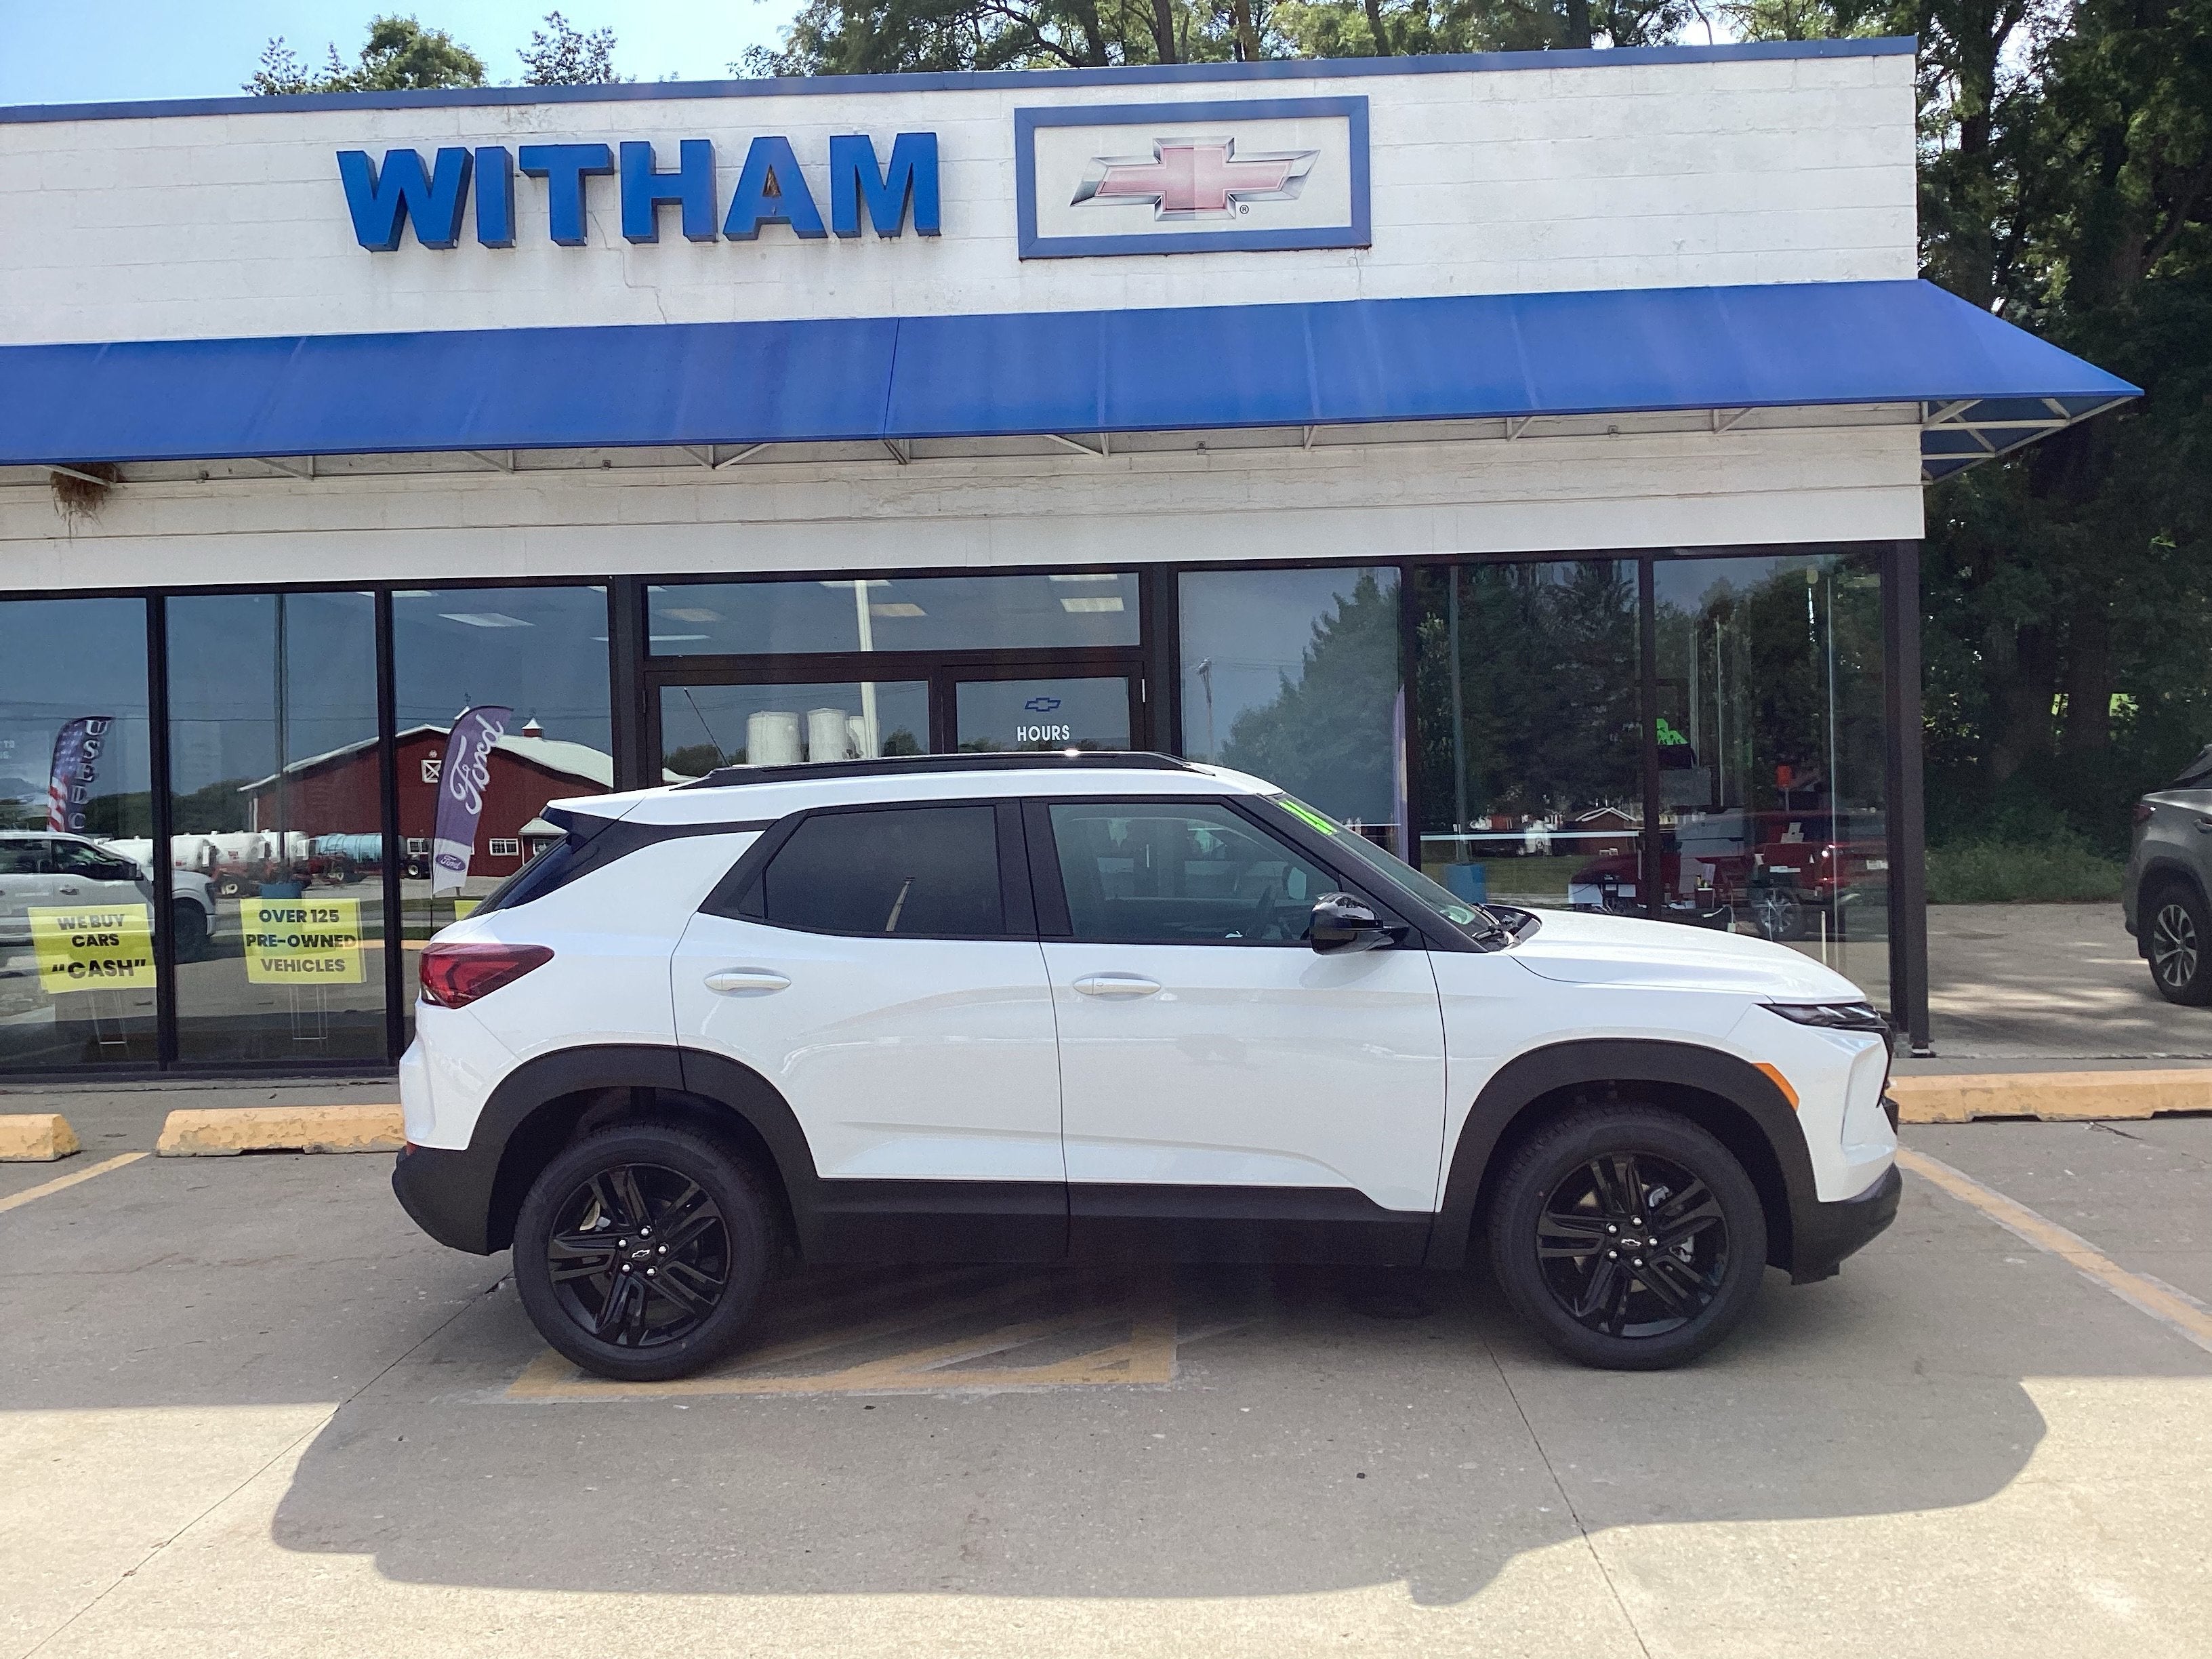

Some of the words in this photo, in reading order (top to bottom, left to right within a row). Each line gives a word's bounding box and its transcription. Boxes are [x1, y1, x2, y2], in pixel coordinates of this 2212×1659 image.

[337, 133, 942, 251] WITHAM
[1017, 724, 1070, 741] HOURS
[69, 720, 110, 804] USED
[450, 714, 504, 815] Ford
[440, 855, 462, 870] Ford
[57, 916, 87, 930] WE
[89, 914, 125, 928] BUY
[259, 909, 307, 923] OVER
[310, 909, 340, 923] 125
[72, 933, 119, 947] CARS
[245, 934, 356, 947] PRE-OWNED
[260, 958, 346, 972] VEHICLES
